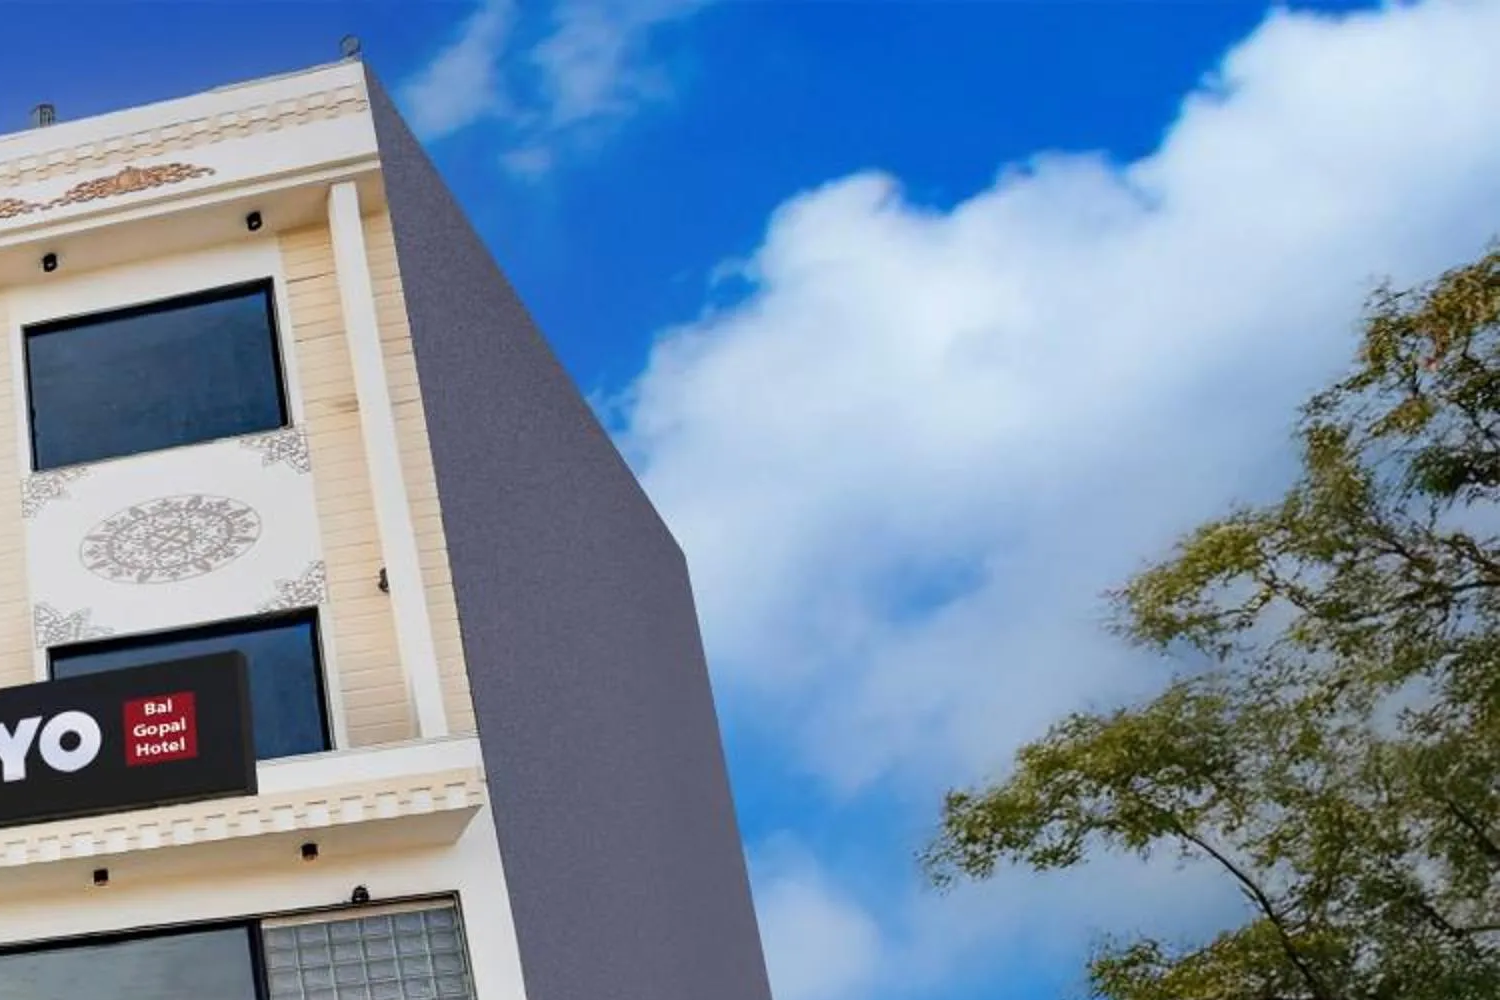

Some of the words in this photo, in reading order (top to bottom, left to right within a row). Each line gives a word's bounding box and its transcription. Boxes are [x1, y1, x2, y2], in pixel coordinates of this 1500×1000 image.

[144, 698, 173, 716] Bal
[133, 716, 187, 738] Gopal
[135, 736, 185, 757] Hotel
